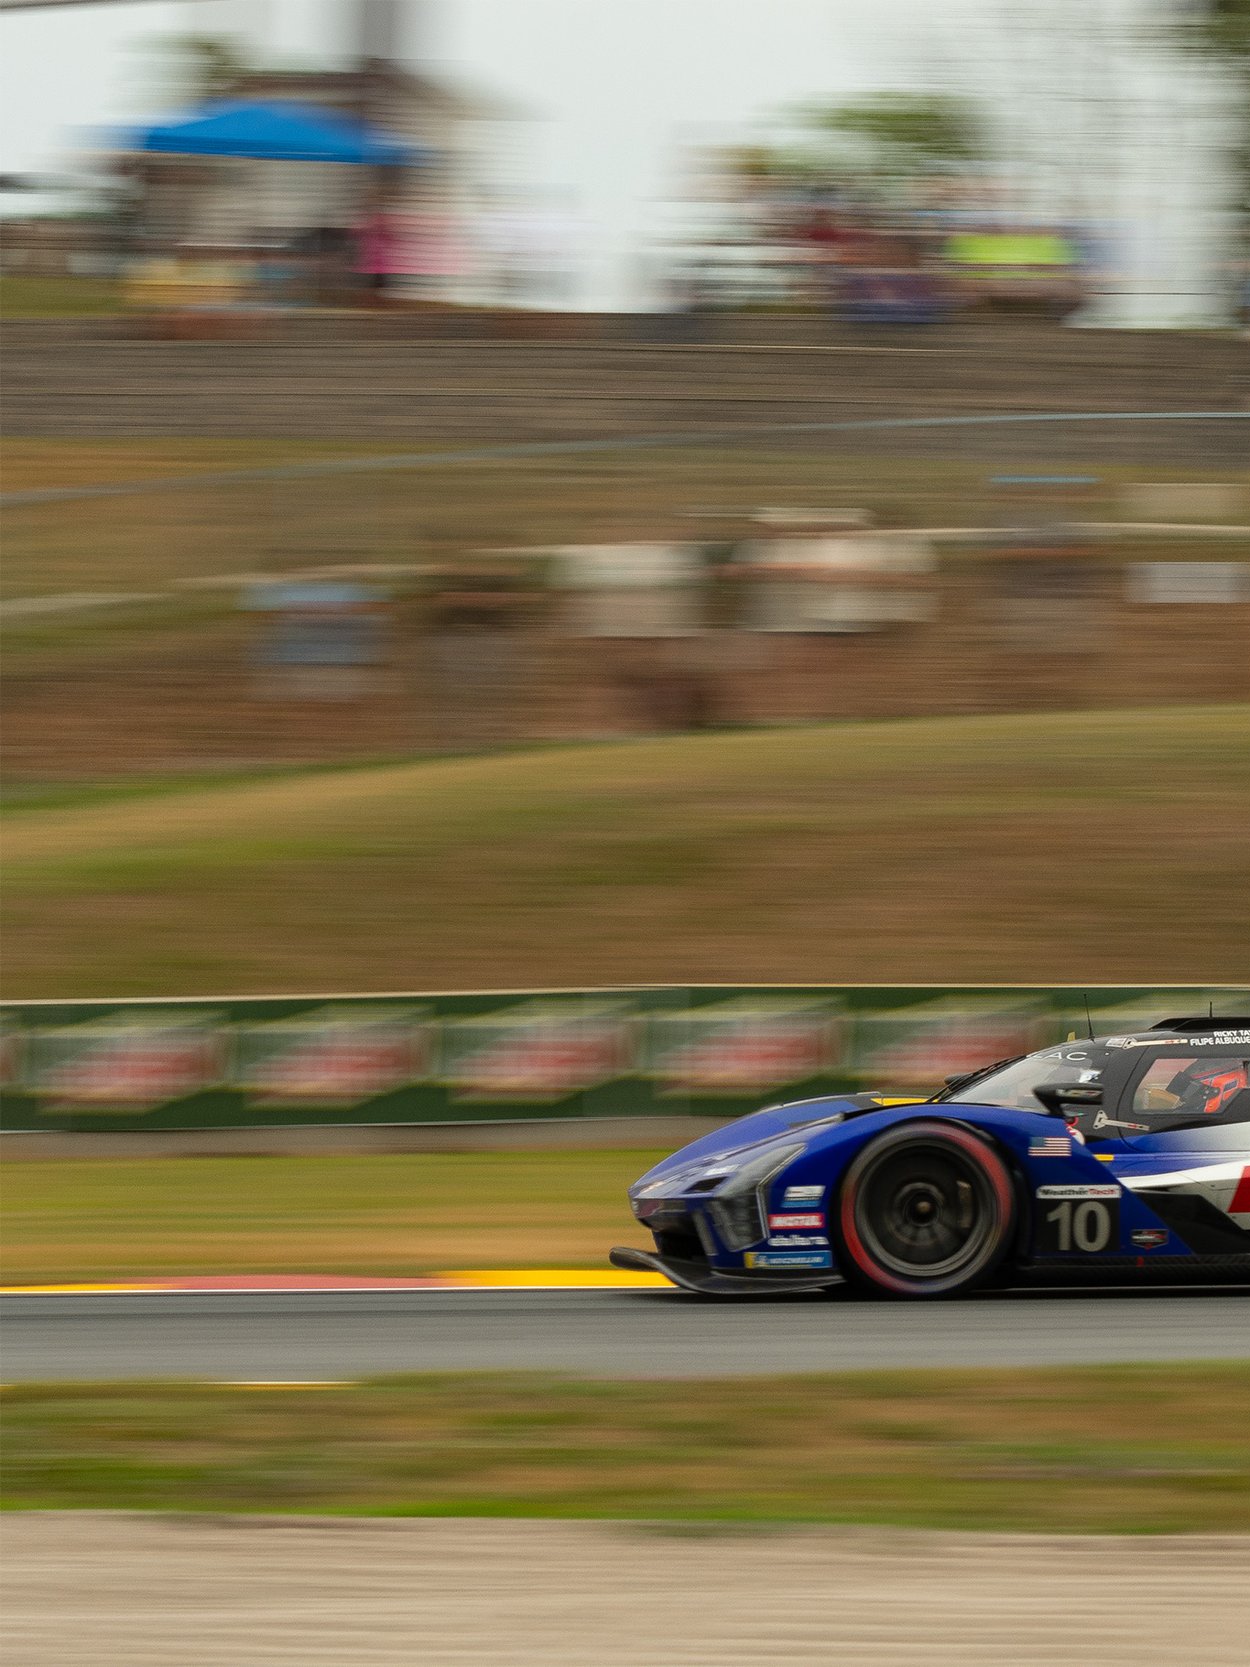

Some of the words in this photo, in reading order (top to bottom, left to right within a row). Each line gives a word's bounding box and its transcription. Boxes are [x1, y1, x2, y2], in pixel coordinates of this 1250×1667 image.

[1213, 1030, 1238, 1038] RICKY
[1190, 1037, 1214, 1047] FILIPE
[1046, 1201, 1111, 1252] 10
